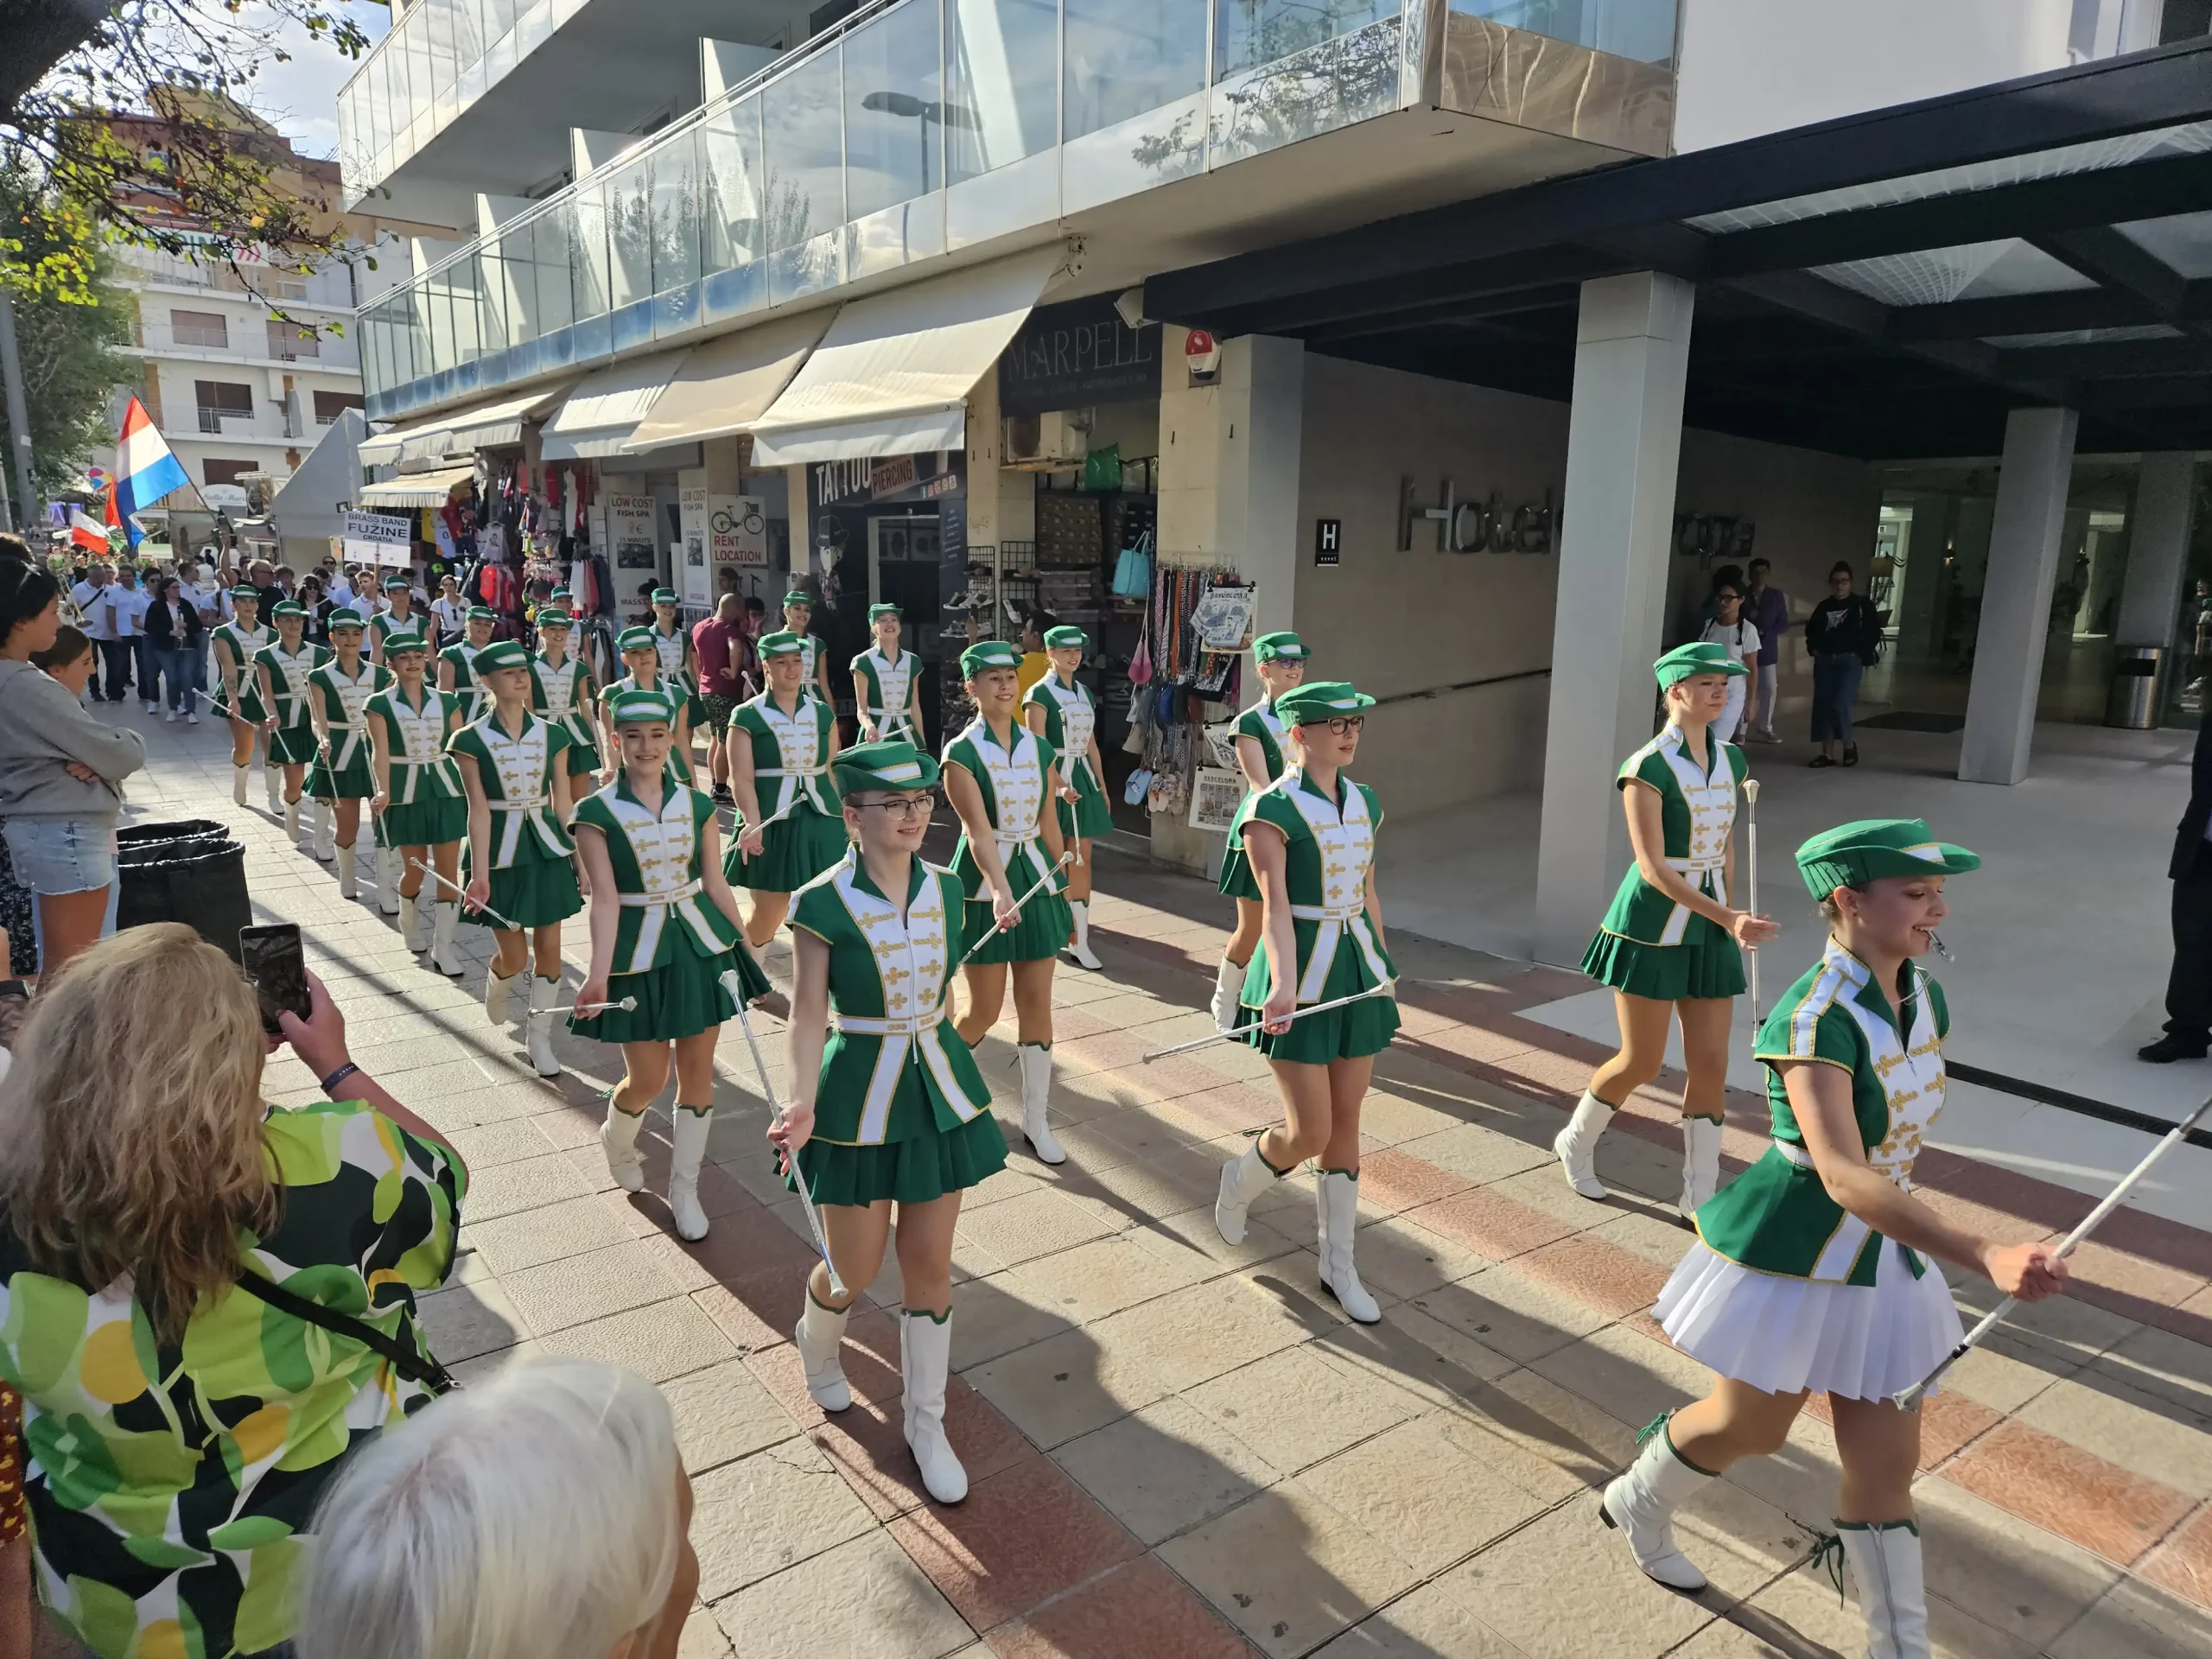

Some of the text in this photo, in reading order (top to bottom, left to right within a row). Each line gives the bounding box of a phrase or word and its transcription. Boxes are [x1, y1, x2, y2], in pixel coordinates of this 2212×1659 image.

[1007, 320, 1153, 382] MARPELL
[816, 456, 871, 506] TATTOO
[873, 460, 913, 494] PIERCING
[693, 490, 706, 501] COST
[611, 498, 654, 509] LOW COST
[348, 512, 408, 526] BRASS BAND
[1397, 475, 1555, 554] Hotel
[347, 522, 408, 538] FUŽINE
[1323, 524, 1337, 549] H
[363, 534, 393, 543] CROATIA
[714, 536, 741, 547] RENT
[715, 550, 761, 563] LOCATION
